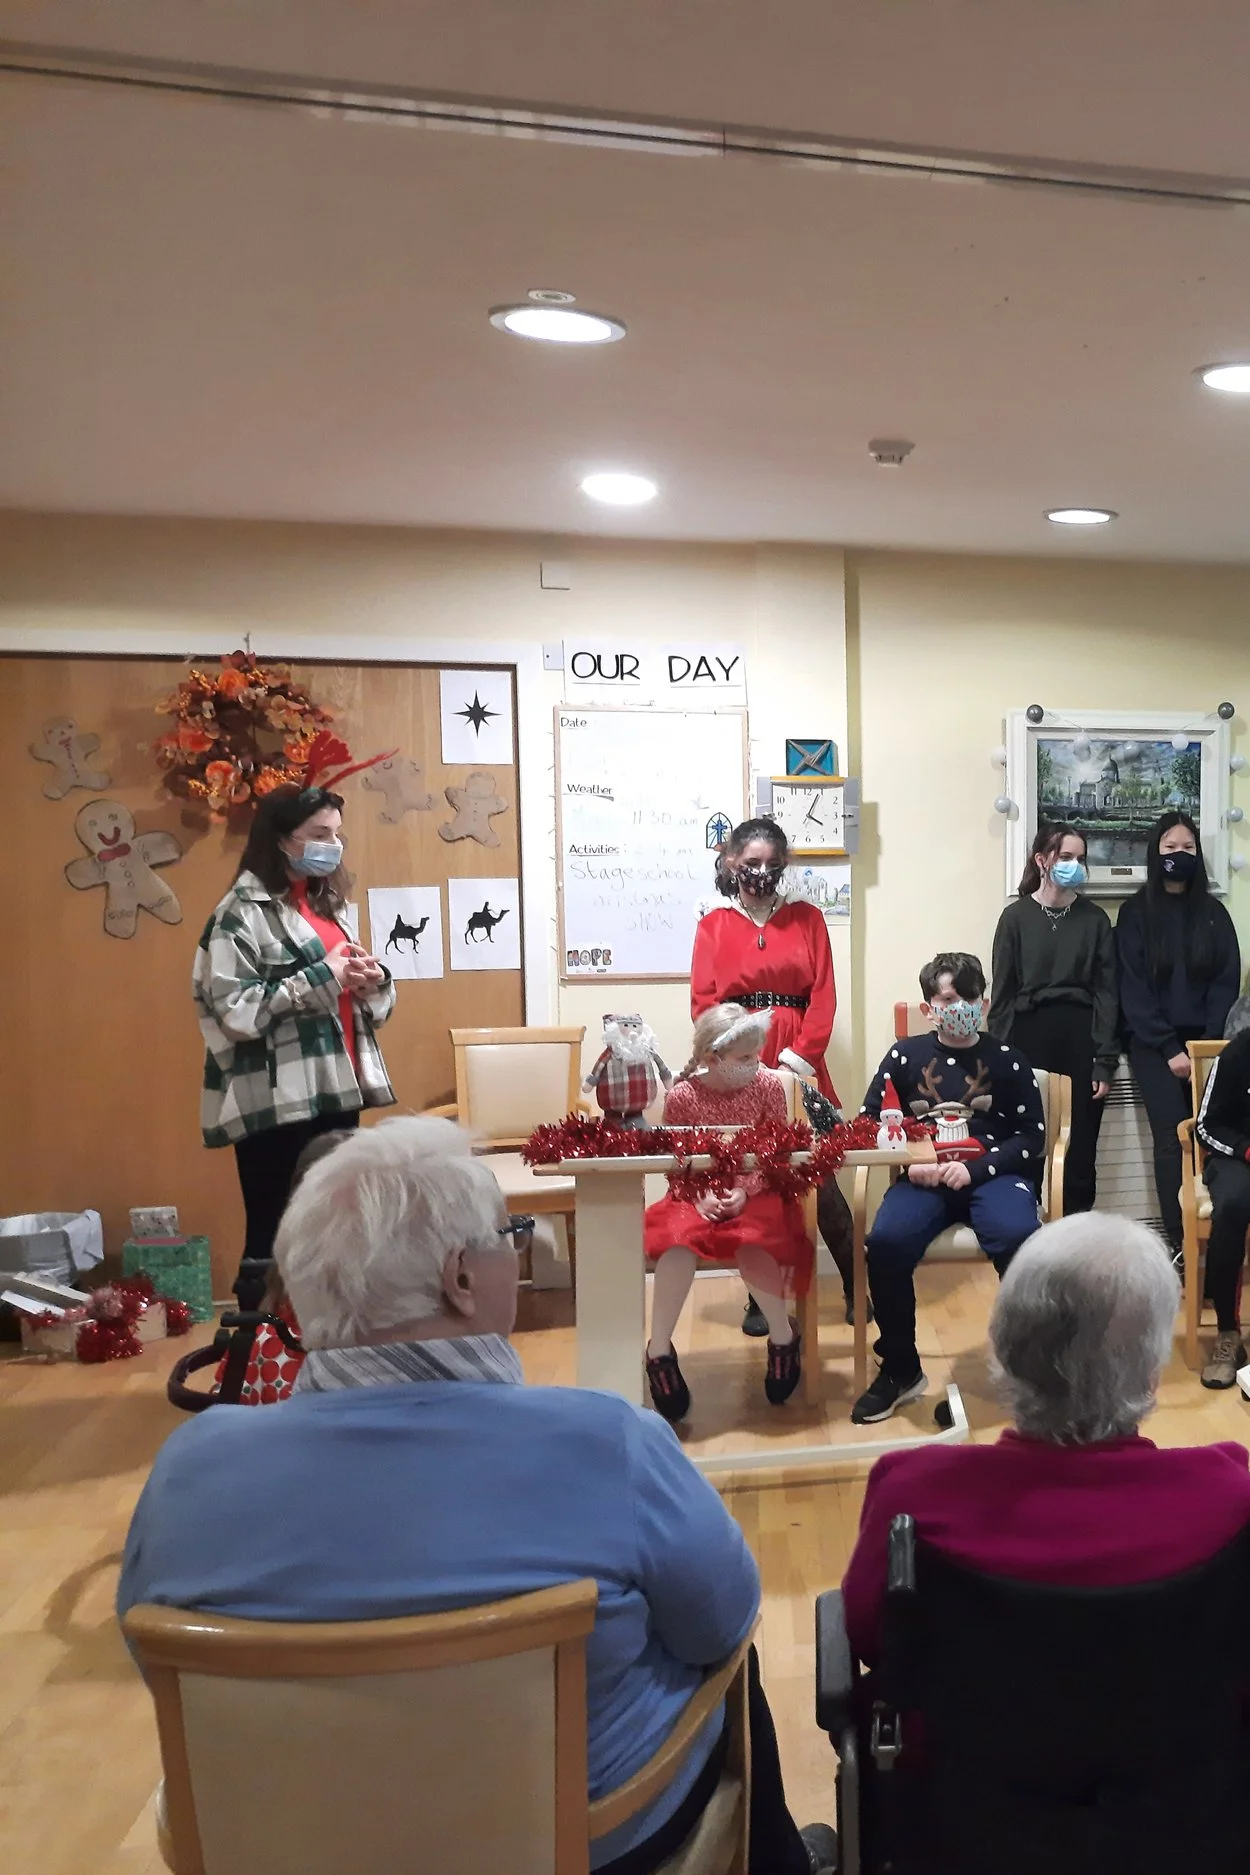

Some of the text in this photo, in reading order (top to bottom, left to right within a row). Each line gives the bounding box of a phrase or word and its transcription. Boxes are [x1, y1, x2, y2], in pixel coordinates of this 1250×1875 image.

[571, 651, 740, 683] OUR DAY
[560, 717, 588, 728] Date
[567, 783, 613, 795] Weather
[832, 796, 838, 805] 2
[833, 812, 838, 820] 3
[791, 834, 797, 843] 7
[805, 834, 811, 843] 6
[569, 843, 620, 855] Activities
[567, 947, 612, 968] HOPE
